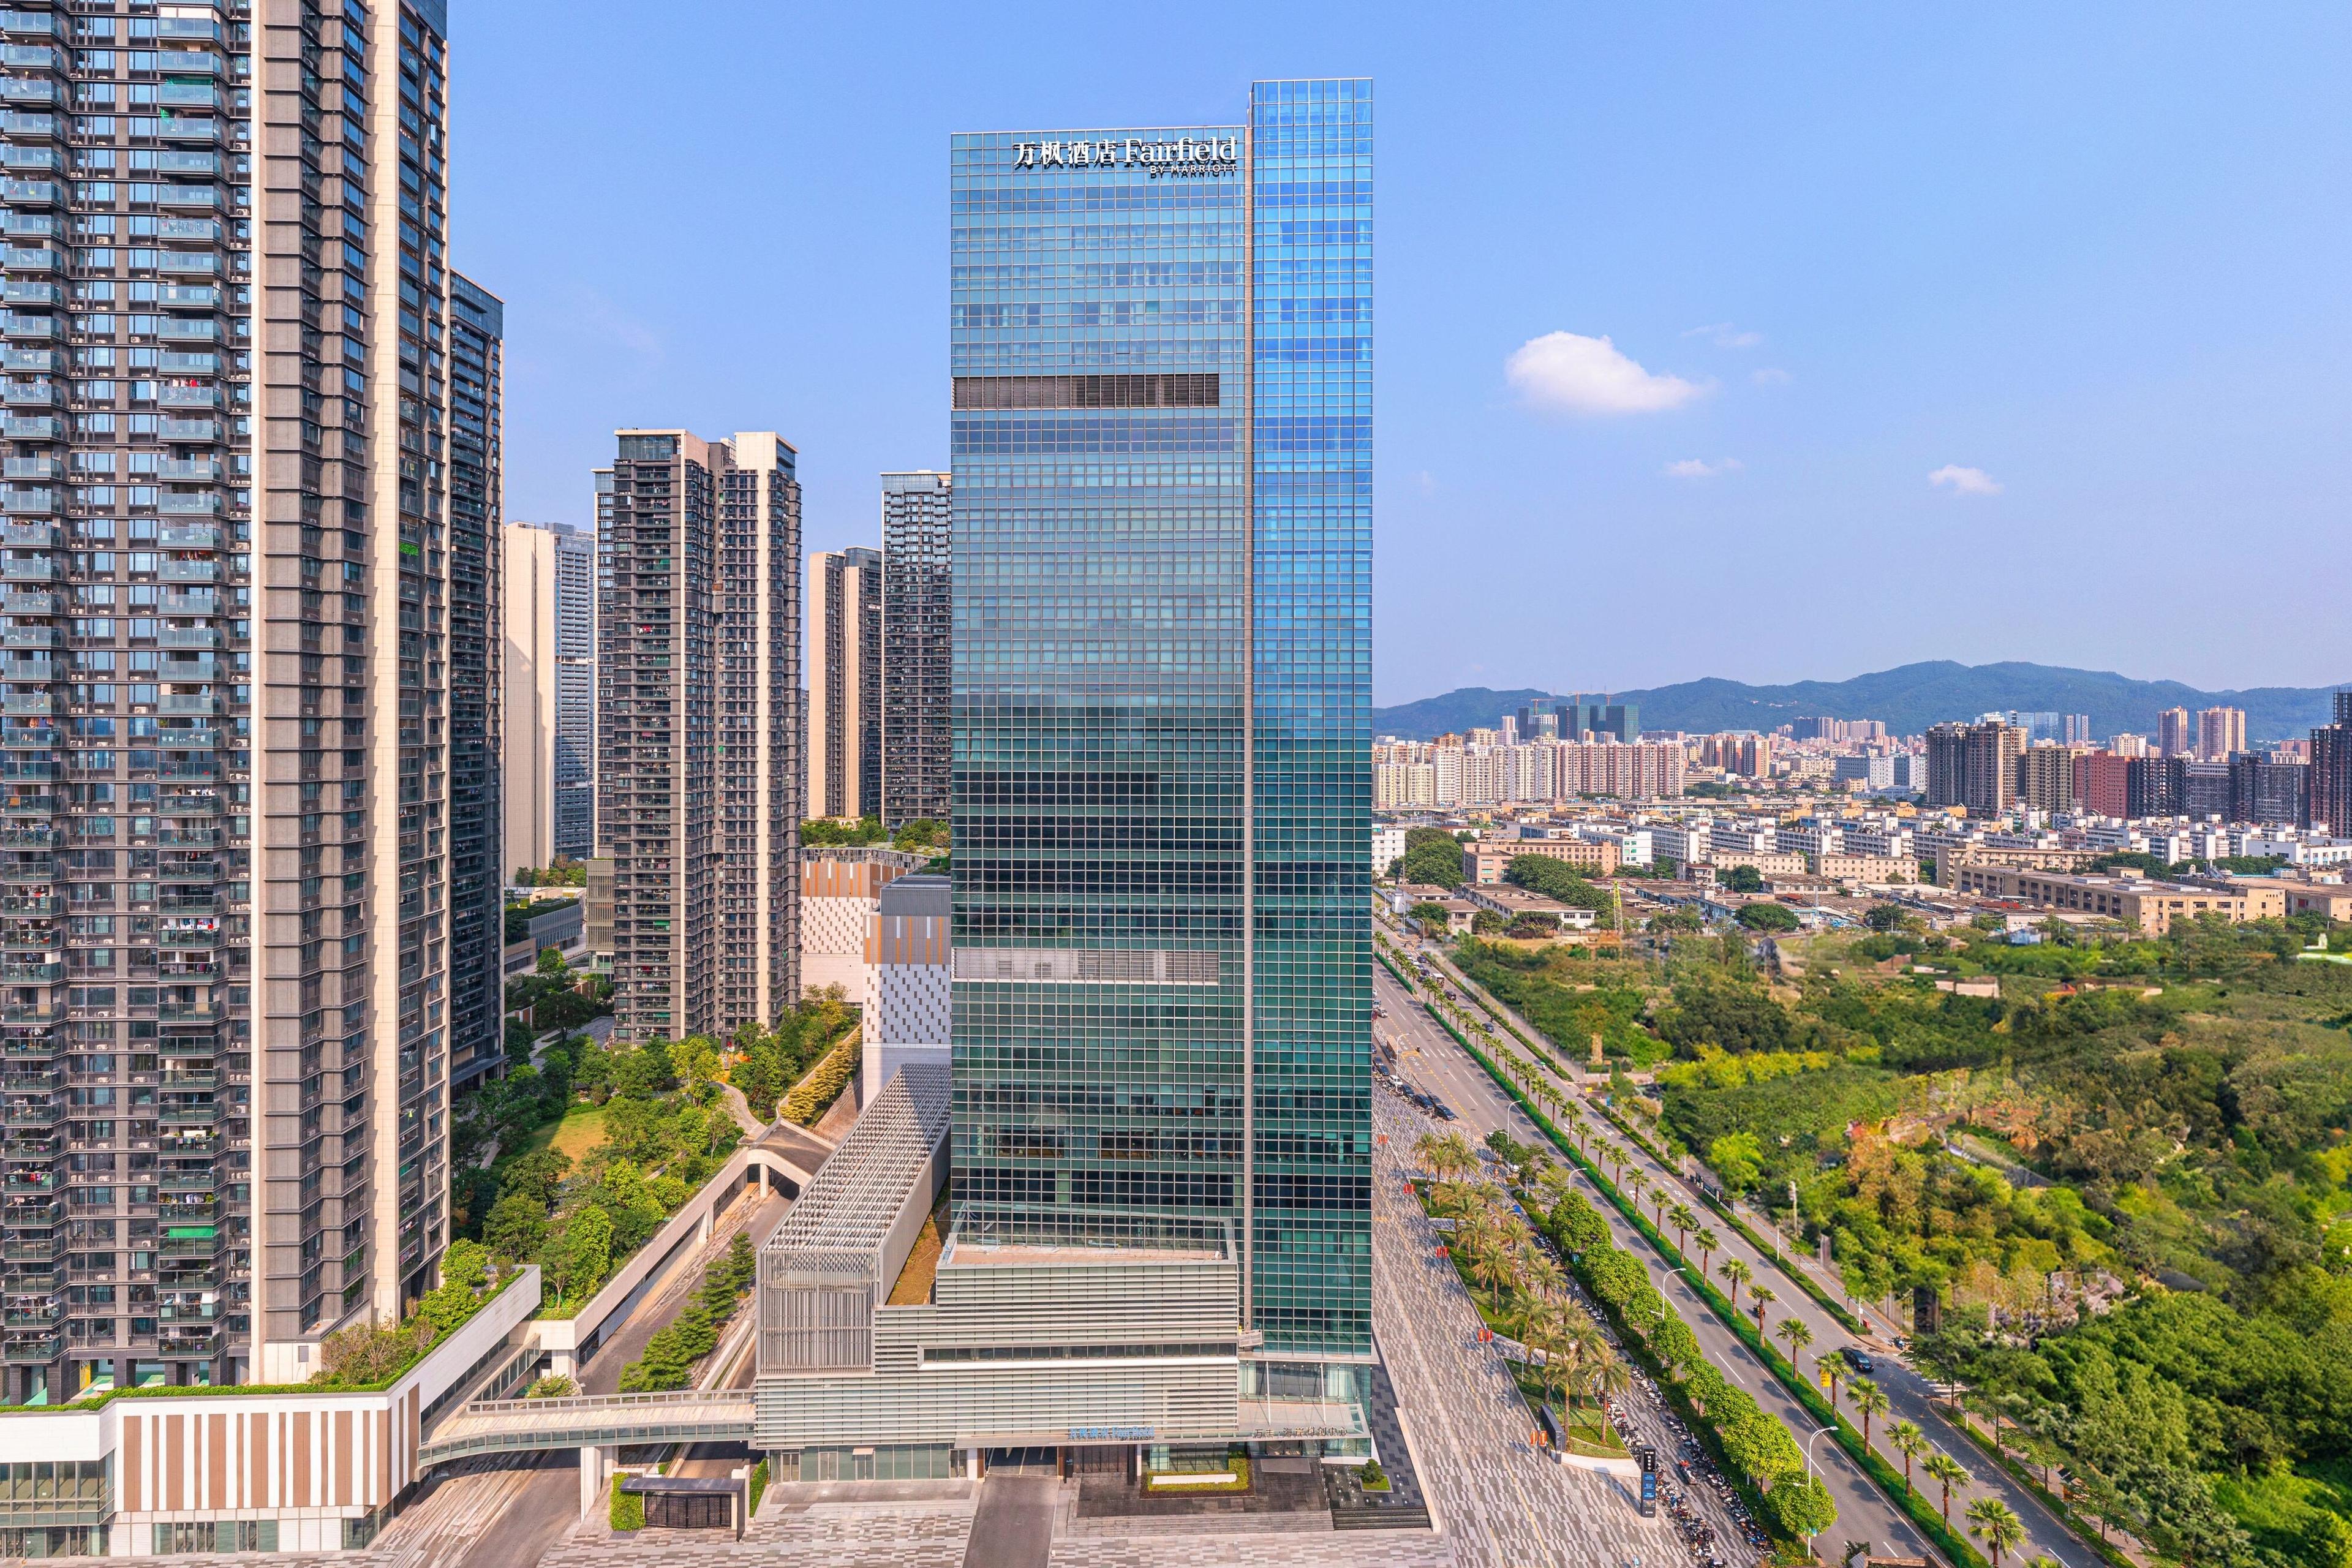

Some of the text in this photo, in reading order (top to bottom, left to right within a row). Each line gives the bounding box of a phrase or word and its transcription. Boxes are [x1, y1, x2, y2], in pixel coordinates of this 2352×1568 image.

[1012, 136, 1237, 166] 万枫酒店 Fairfield
[1170, 164, 1237, 173] MARRIOTT
